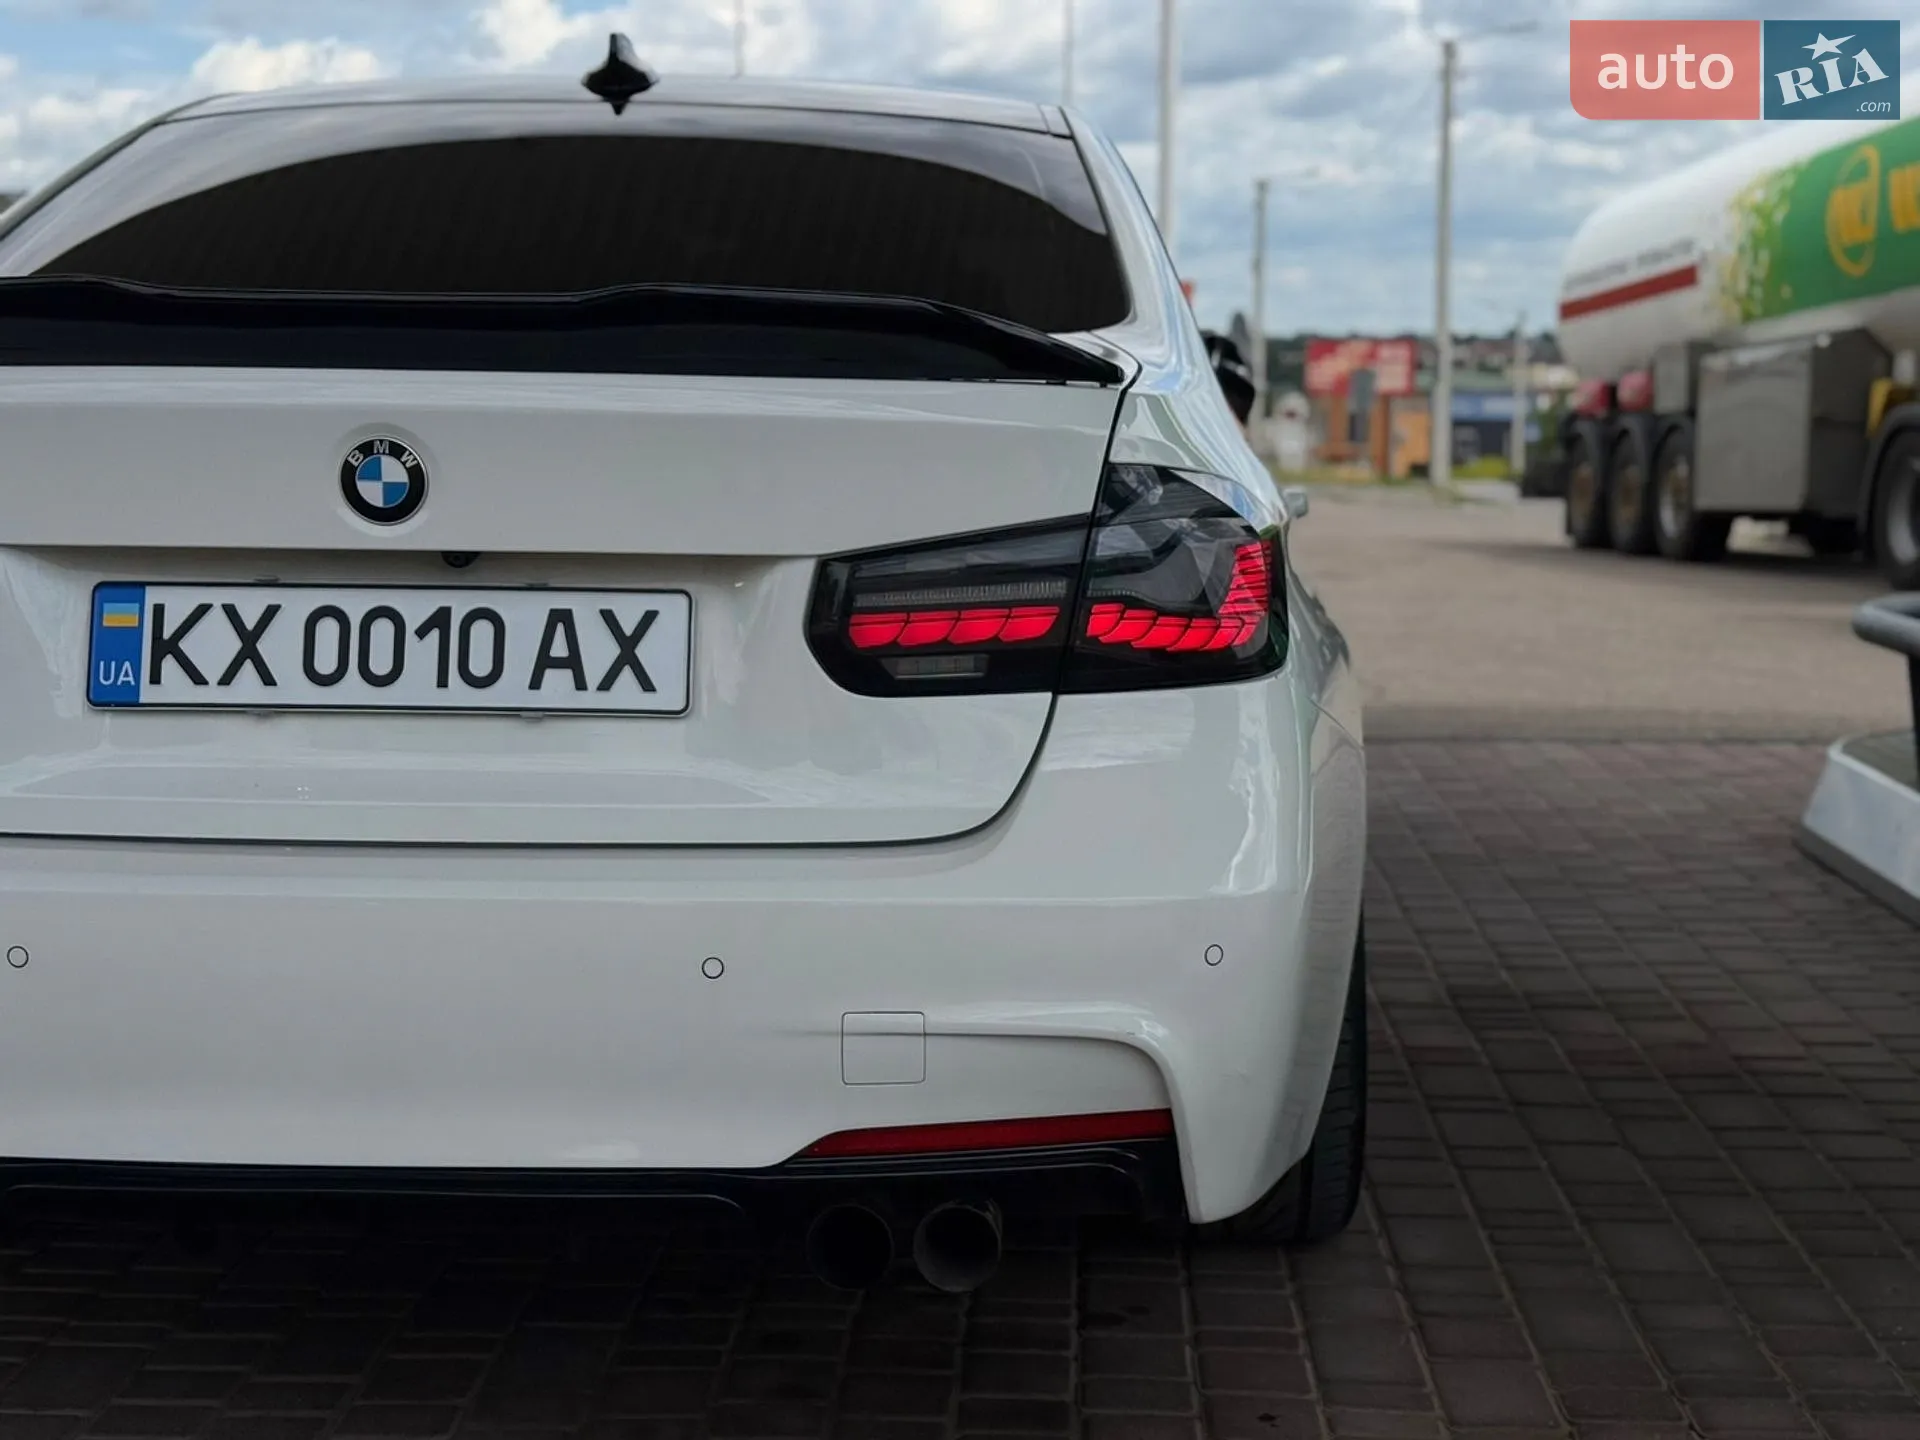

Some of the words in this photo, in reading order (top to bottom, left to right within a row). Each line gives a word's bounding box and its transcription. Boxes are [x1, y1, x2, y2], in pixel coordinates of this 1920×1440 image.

[346, 440, 418, 469] BMW
[149, 603, 282, 686] KX
[302, 604, 506, 689] 0010
[527, 608, 660, 692] AX
[99, 661, 136, 686] UA
